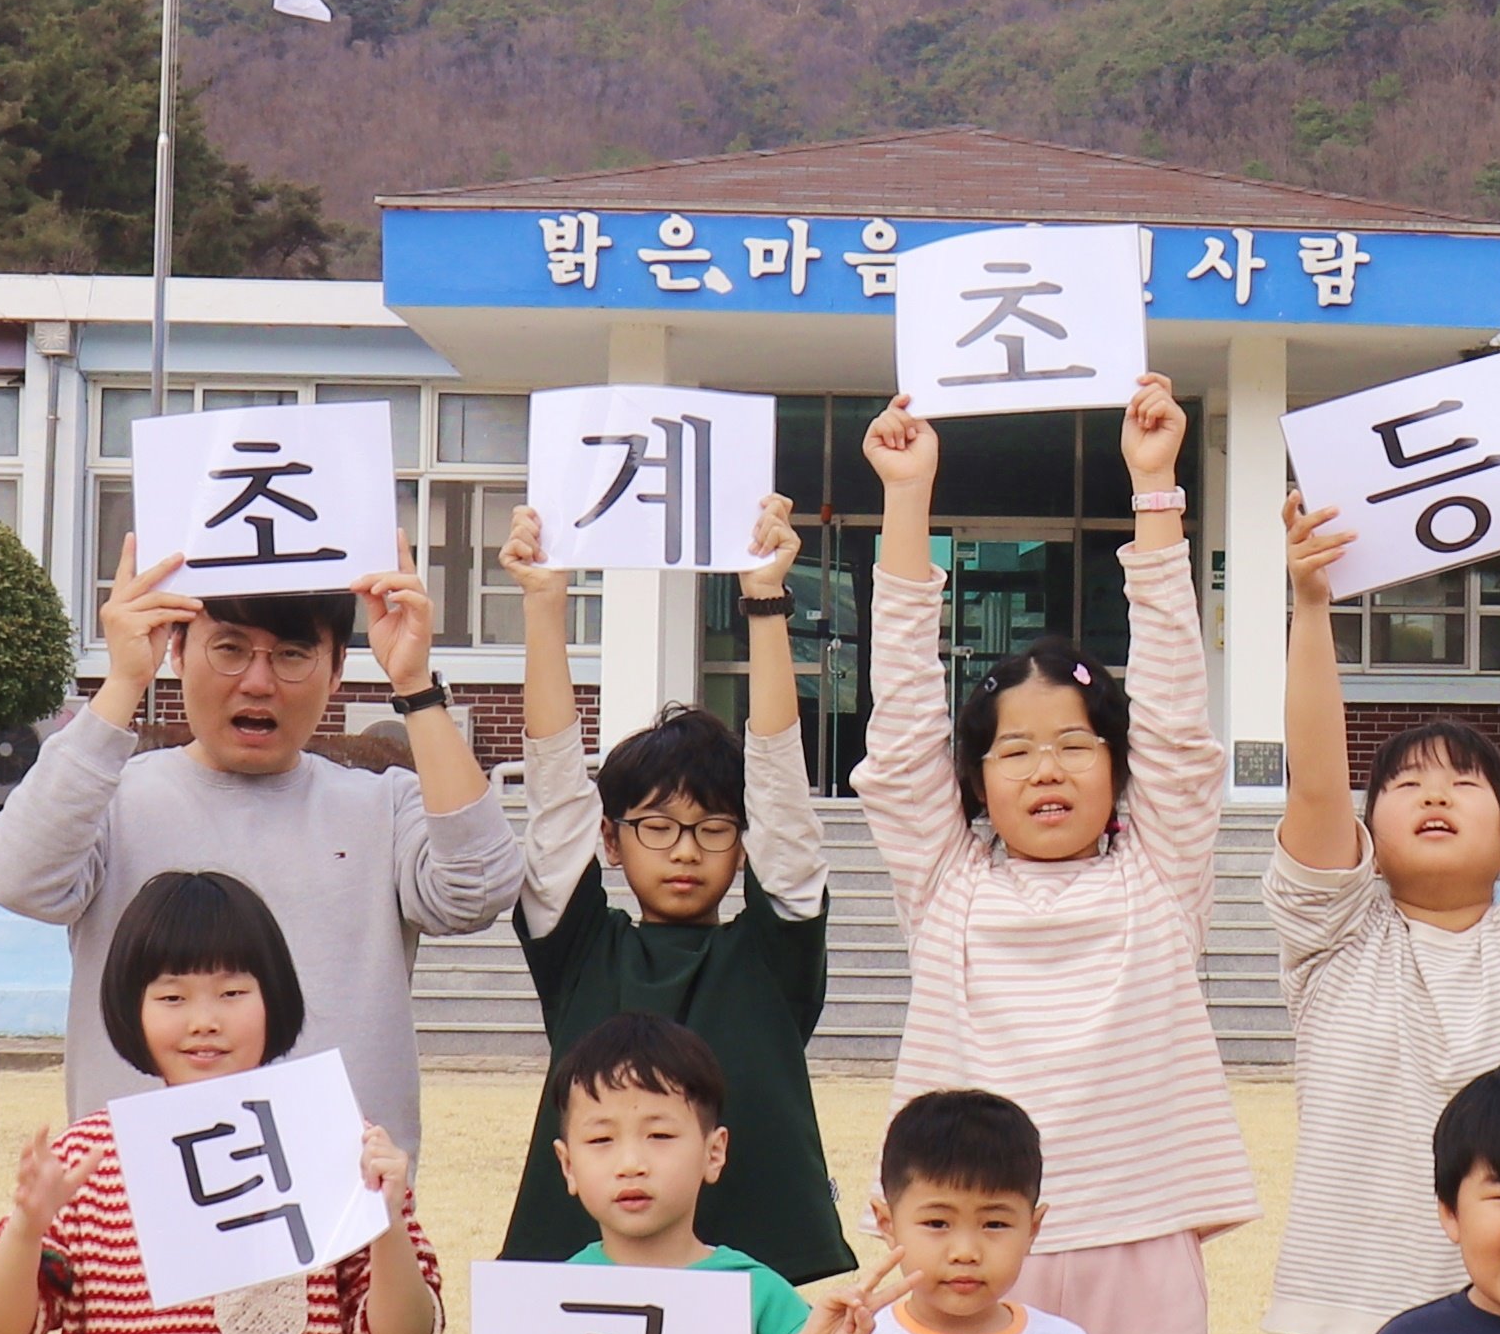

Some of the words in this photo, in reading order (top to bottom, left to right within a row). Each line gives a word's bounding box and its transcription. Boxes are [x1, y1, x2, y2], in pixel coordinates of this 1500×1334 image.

[537, 210, 712, 291] 밝은
[742, 217, 897, 298] 마음
[1186, 227, 1371, 308] 사람
[937, 261, 1097, 387] 초
[186, 441, 347, 570] 초
[574, 413, 712, 567] 계
[171, 1099, 315, 1266] 덕
